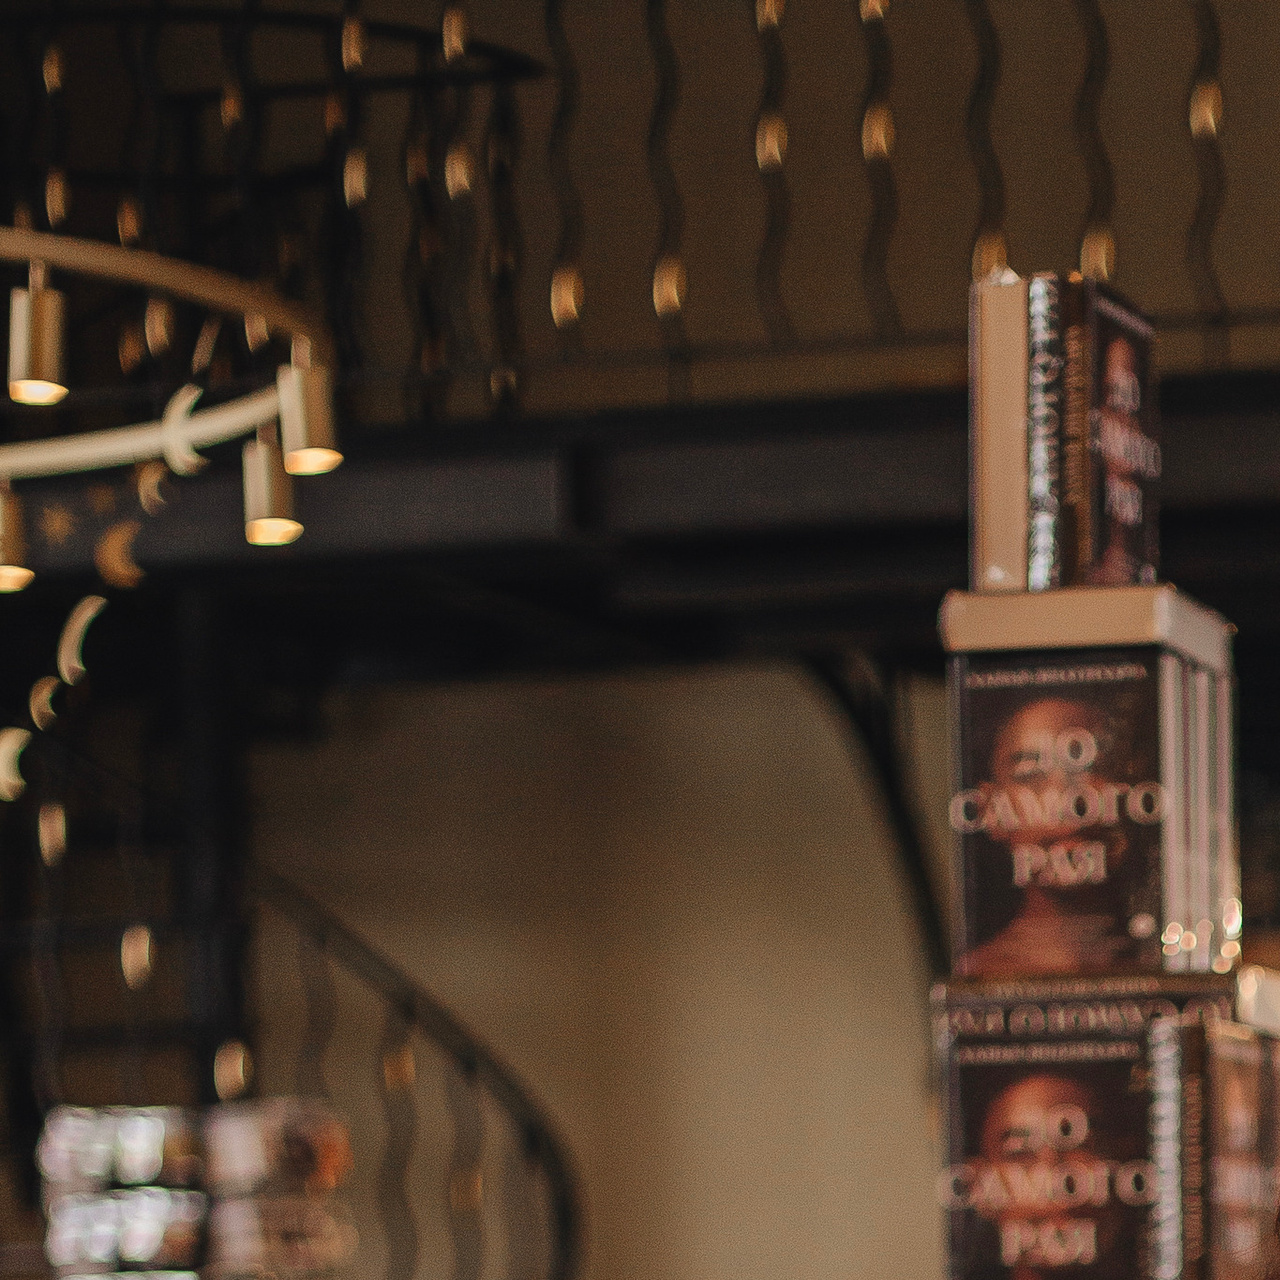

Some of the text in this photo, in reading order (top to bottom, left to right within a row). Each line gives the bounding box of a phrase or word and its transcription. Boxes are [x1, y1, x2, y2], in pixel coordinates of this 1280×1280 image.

[949, 778, 1165, 834] САМОГО
[1012, 842, 1106, 888] РАЯ
[938, 1160, 1162, 1212] САМОГО
